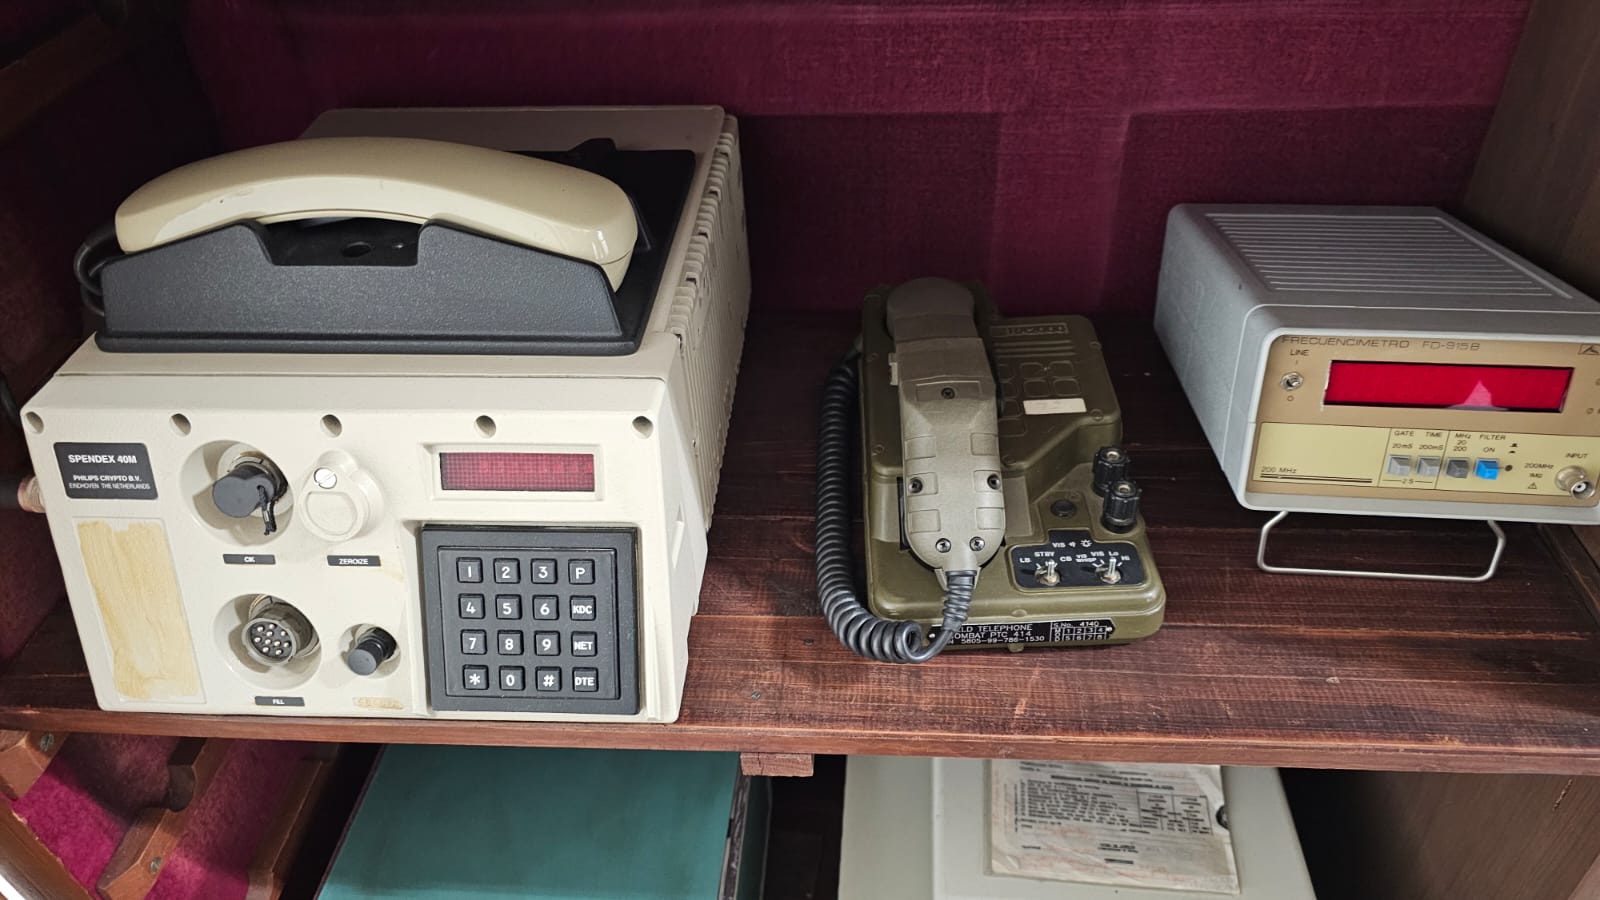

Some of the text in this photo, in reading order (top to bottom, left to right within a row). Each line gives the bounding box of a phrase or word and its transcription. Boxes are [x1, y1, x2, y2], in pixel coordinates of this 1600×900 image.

[1282, 337, 1480, 350] FRECUENCIMETRO FD-915B
[68, 454, 138, 464] SPENDEX 40M
[501, 566, 511, 579] 2
[538, 566, 548, 578] 3
[575, 567, 586, 580] P
[466, 602, 476, 614] 4
[502, 602, 512, 615] 5
[540, 603, 550, 616] 6
[572, 605, 593, 614] KDC
[978, 624, 1033, 632] TELEPHONE
[468, 638, 477, 650] 7
[504, 638, 514, 651] 8
[542, 638, 552, 651] 9
[574, 641, 593, 650] NET
[506, 674, 515, 686] 0
[574, 676, 595, 686] DTE
